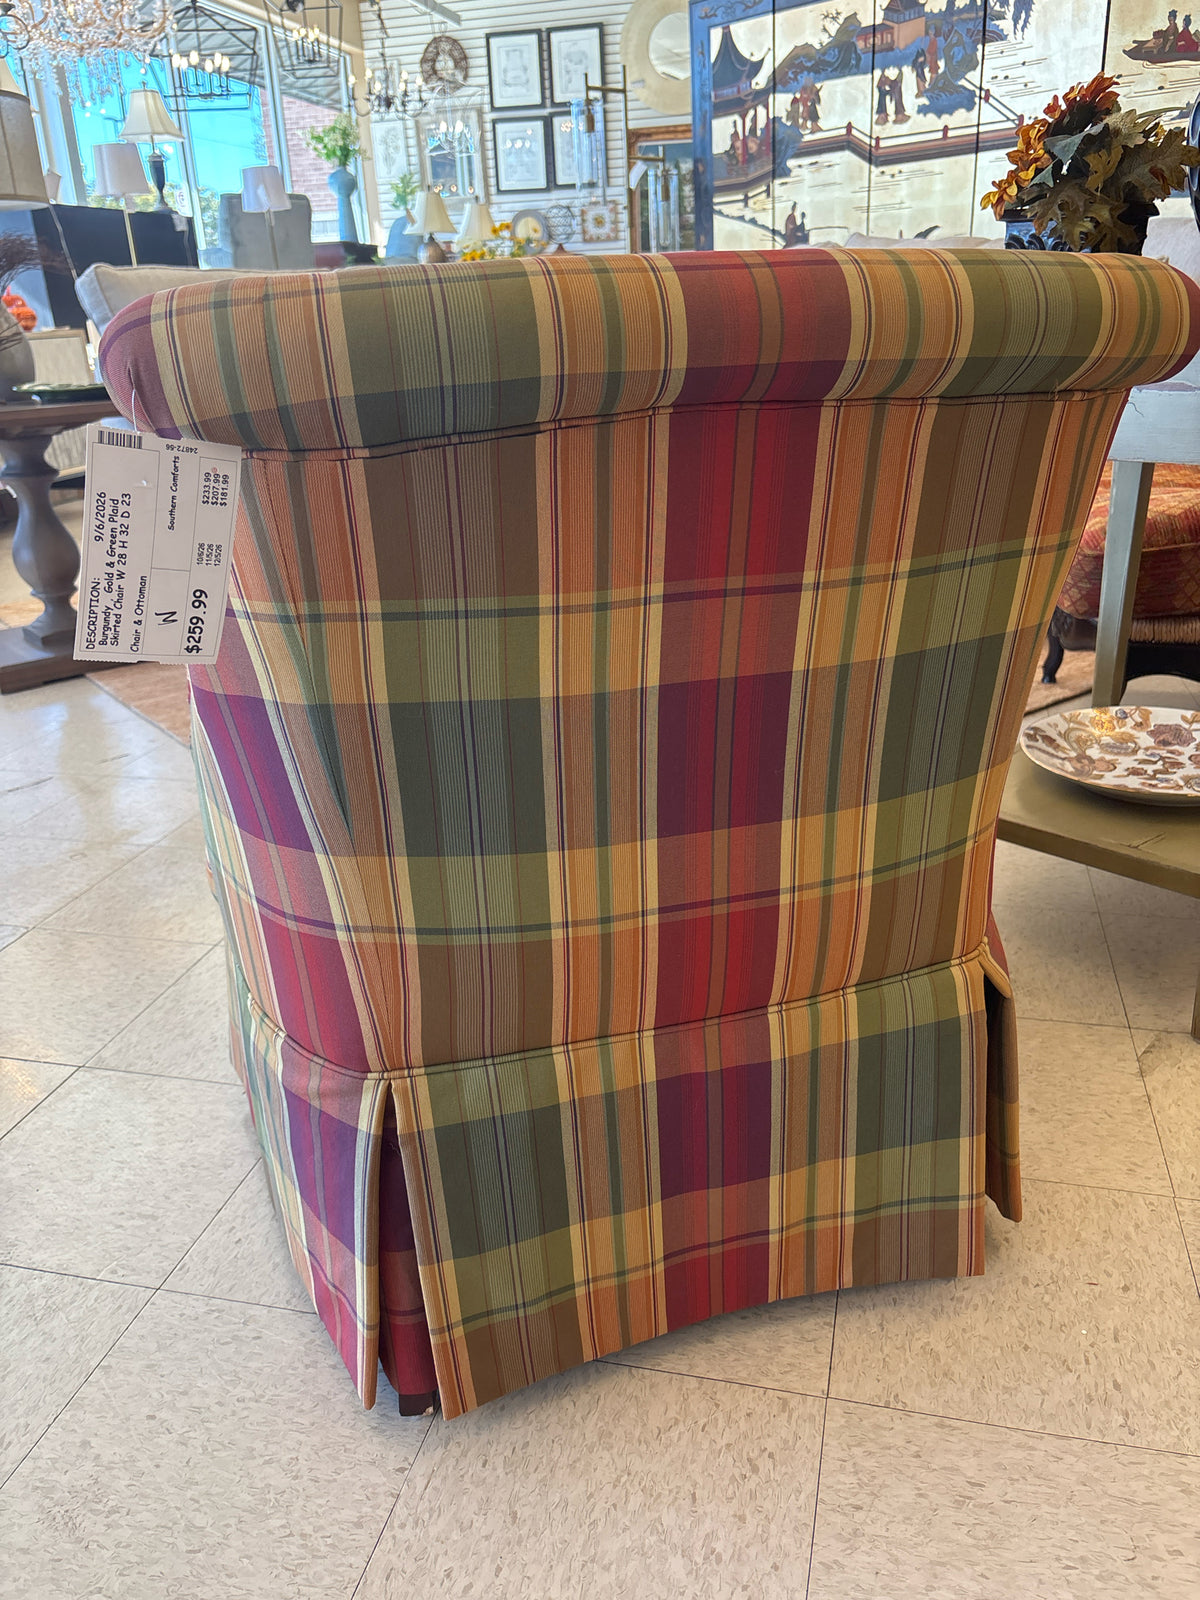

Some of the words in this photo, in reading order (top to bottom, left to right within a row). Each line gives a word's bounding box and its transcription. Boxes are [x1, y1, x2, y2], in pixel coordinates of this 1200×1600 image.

[170, 455, 180, 492] Comforts
[202, 472, 212, 505] $233.99
[121, 492, 131, 507] 23
[211, 473, 221, 506] $207.99
[220, 474, 230, 507] $181.99
[94, 492, 107, 542] 9/6/2026
[108, 498, 119, 523] Plaid
[120, 510, 131, 519] D
[168, 495, 177, 531] Southern
[107, 527, 118, 557] Green
[119, 523, 129, 537] 32
[119, 540, 128, 549] H
[106, 561, 115, 569] &
[116, 569, 126, 580] W
[117, 553, 127, 566] 28
[104, 572, 114, 593] Gold
[113, 584, 125, 610] Chair
[135, 575, 148, 616] Ottoman
[86, 577, 101, 650] DESCRIPTION:
[99, 605, 113, 646] Burgundy
[184, 589, 209, 654] $259.99
[110, 613, 122, 647] Skirted
[130, 630, 141, 653] Chair
